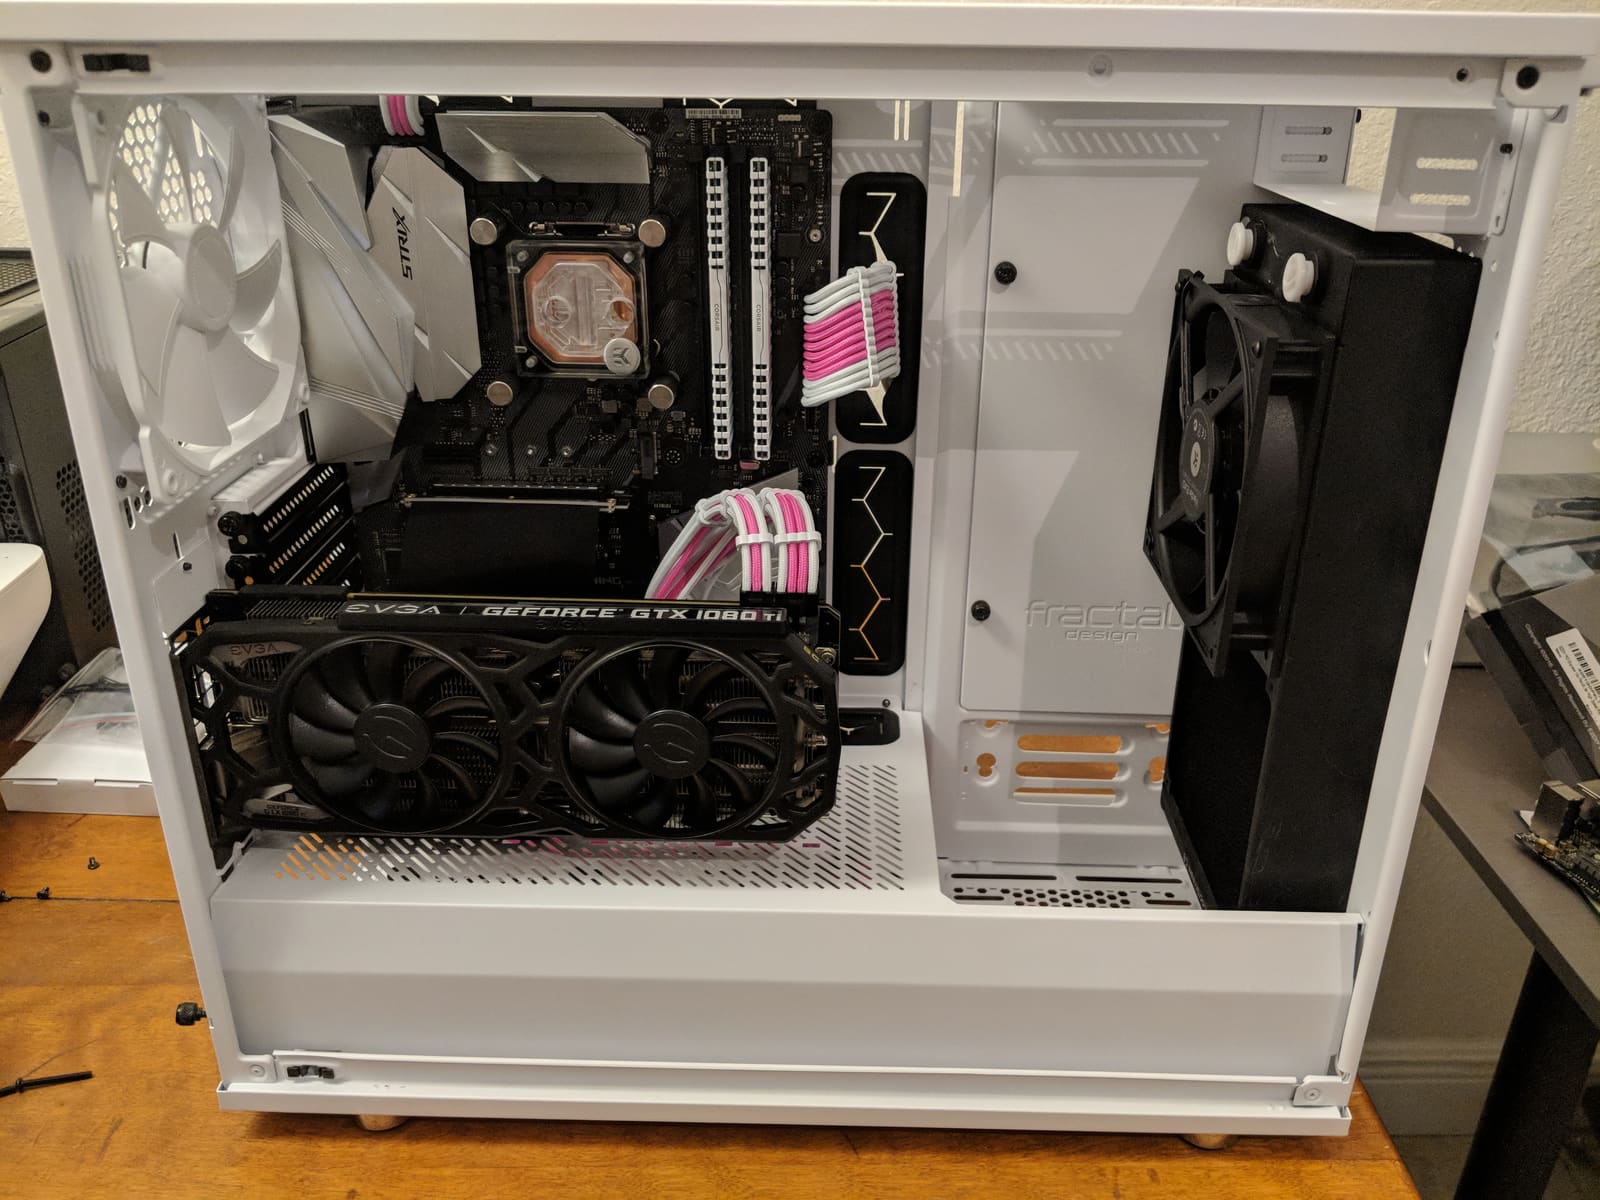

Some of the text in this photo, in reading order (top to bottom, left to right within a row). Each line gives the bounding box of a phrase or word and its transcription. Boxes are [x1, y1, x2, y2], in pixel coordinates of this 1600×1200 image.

[392, 207, 413, 280] STRIX
[345, 604, 441, 615] EVGA
[482, 606, 615, 618] GEFORCE
[630, 608, 689, 620] GTX
[696, 610, 757, 621] 1080
[1024, 600, 1183, 630] fractal
[1065, 629, 1139, 643] design
[231, 643, 278, 656] EVGA
